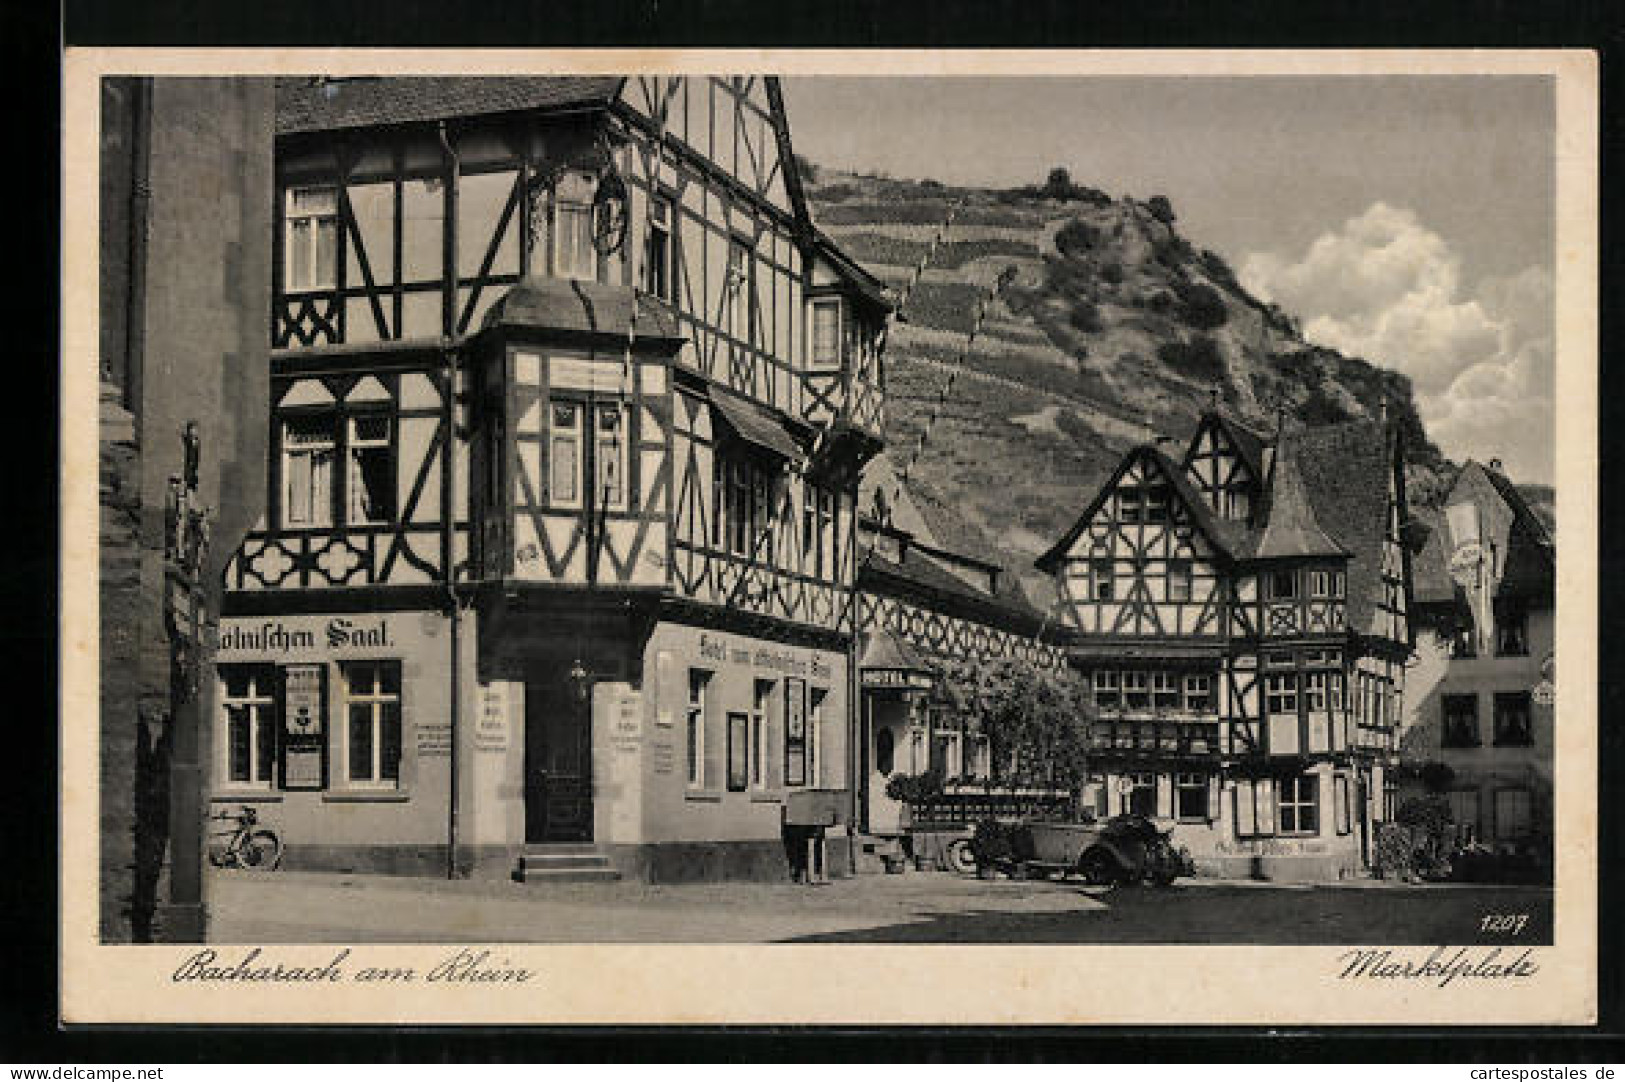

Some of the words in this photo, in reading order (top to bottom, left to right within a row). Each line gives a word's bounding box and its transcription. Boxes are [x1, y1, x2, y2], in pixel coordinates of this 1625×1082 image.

[220, 623, 314, 652] ölnischen
[172, 948, 351, 982] Bacharach
[355, 964, 416, 982] am
[425, 948, 532, 982] Rhein
[1338, 946, 1540, 988] Marktplatz
